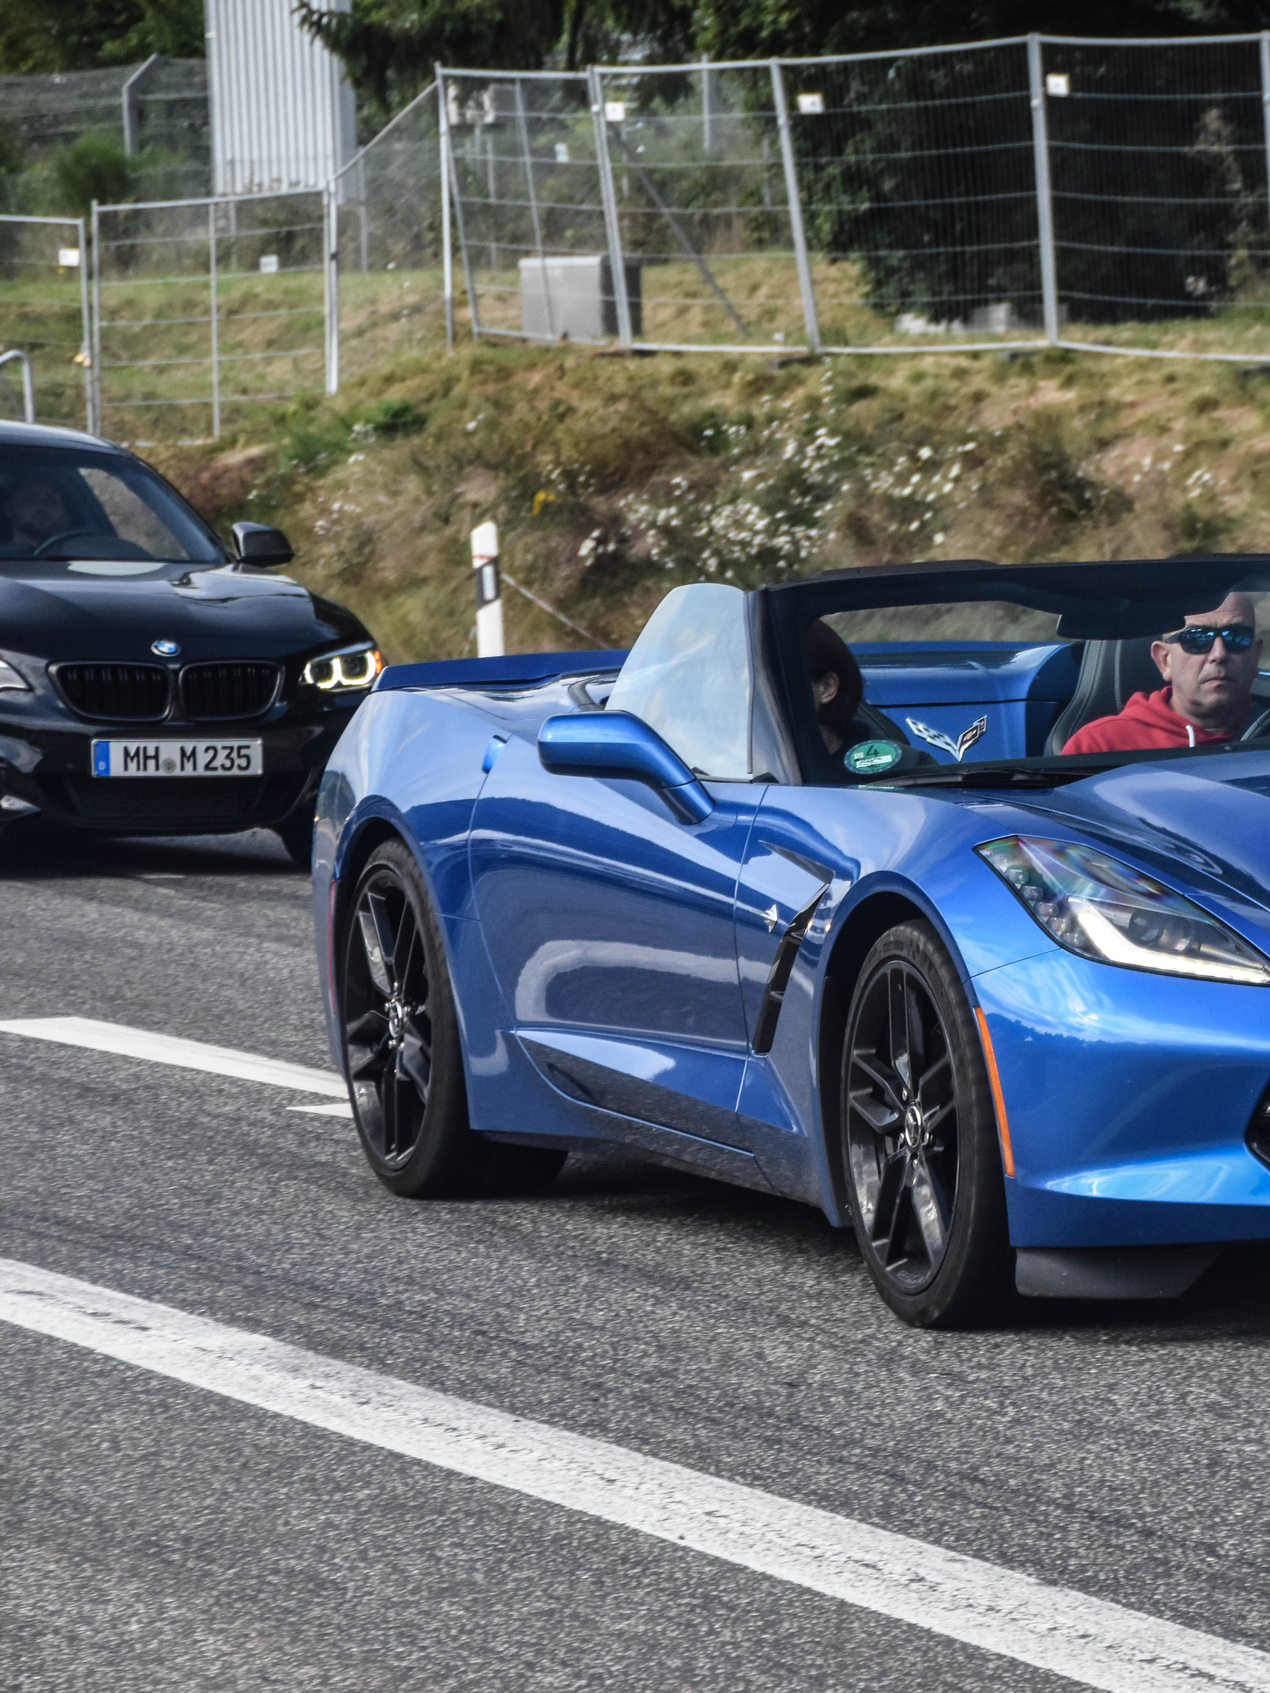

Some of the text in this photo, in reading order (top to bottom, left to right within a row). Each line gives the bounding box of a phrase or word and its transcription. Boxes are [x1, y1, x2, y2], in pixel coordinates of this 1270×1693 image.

[123, 745, 252, 772] MH M 235
